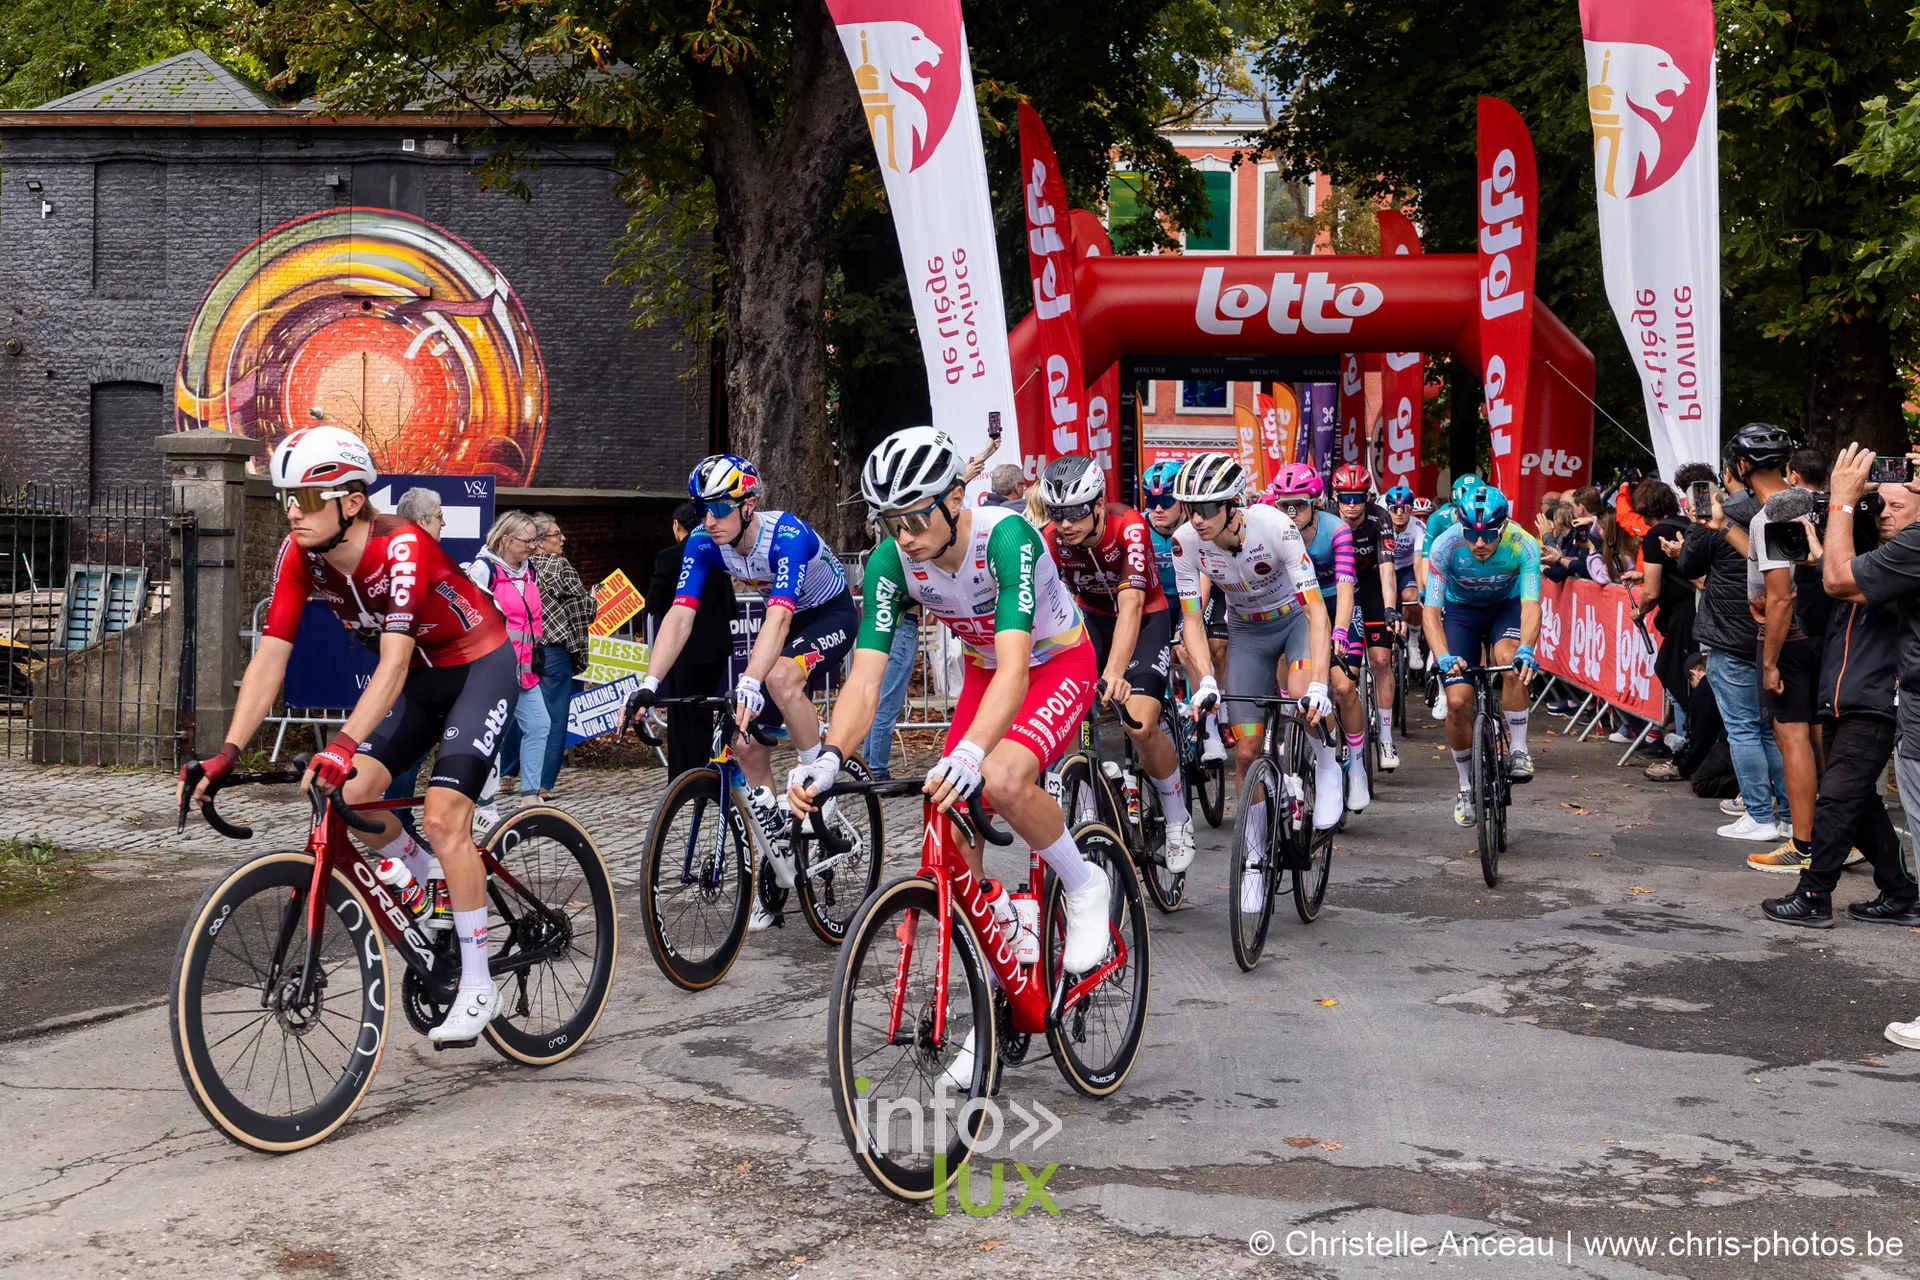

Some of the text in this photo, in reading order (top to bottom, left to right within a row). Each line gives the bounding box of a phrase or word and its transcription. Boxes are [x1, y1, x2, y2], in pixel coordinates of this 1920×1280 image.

[1195, 267, 1384, 335] lotto
[464, 481, 487, 495] VSL
[1860, 502, 1868, 511] 5
[778, 524, 800, 536] BORA
[1123, 523, 1145, 572] lotto
[387, 533, 417, 607] lotto
[607, 573, 625, 595] VIP
[676, 556, 694, 589] BOSS
[776, 557, 789, 589] BOSS
[795, 564, 806, 596] BORA
[1018, 543, 1033, 615] KOMETA
[436, 581, 483, 627] Intermarché
[600, 592, 643, 630] PARKING
[876, 576, 897, 632] KOMETA
[818, 629, 846, 650] BORA
[1569, 593, 1606, 681] lotto
[576, 677, 638, 713] PARKING PMR
[1035, 677, 1080, 726] POLTI
[473, 699, 507, 757] lotto
[730, 806, 752, 875] roval
[1086, 836, 1114, 846] SCOPE
[353, 861, 435, 972] ORBEA
[653, 885, 675, 958] roval
[814, 903, 843, 934] roval
[955, 869, 1027, 995] AURUM
[957, 924, 984, 983] SCOPE
[1100, 963, 1119, 981] AURUM
[1064, 992, 1081, 1009] LECHLER
[1089, 1072, 1116, 1083] SCOPE
